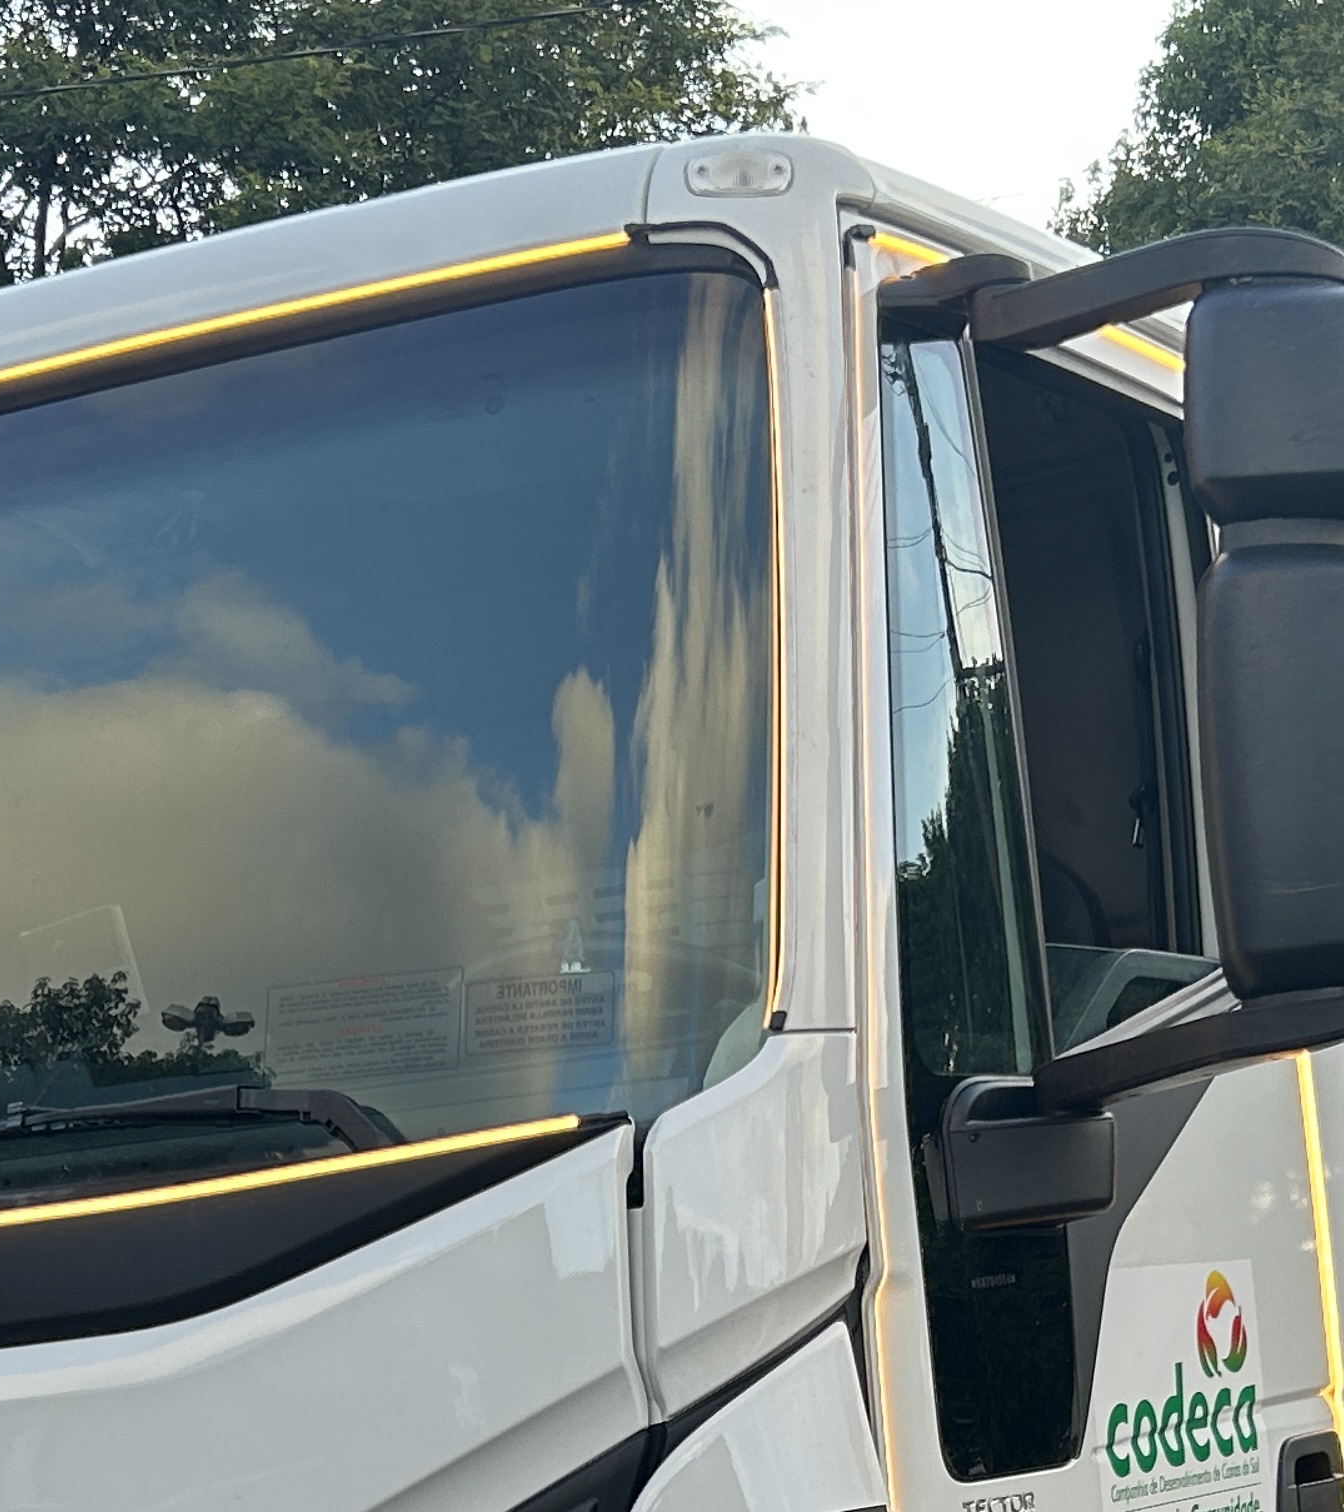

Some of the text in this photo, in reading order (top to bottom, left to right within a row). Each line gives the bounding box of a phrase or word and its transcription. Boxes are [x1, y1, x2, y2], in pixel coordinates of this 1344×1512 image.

[1105, 1363, 1258, 1478] codeca
[1111, 1477, 1149, 1505] Companhia
[1150, 1476, 1158, 1495] de
[1250, 1455, 1260, 1475] Sul
